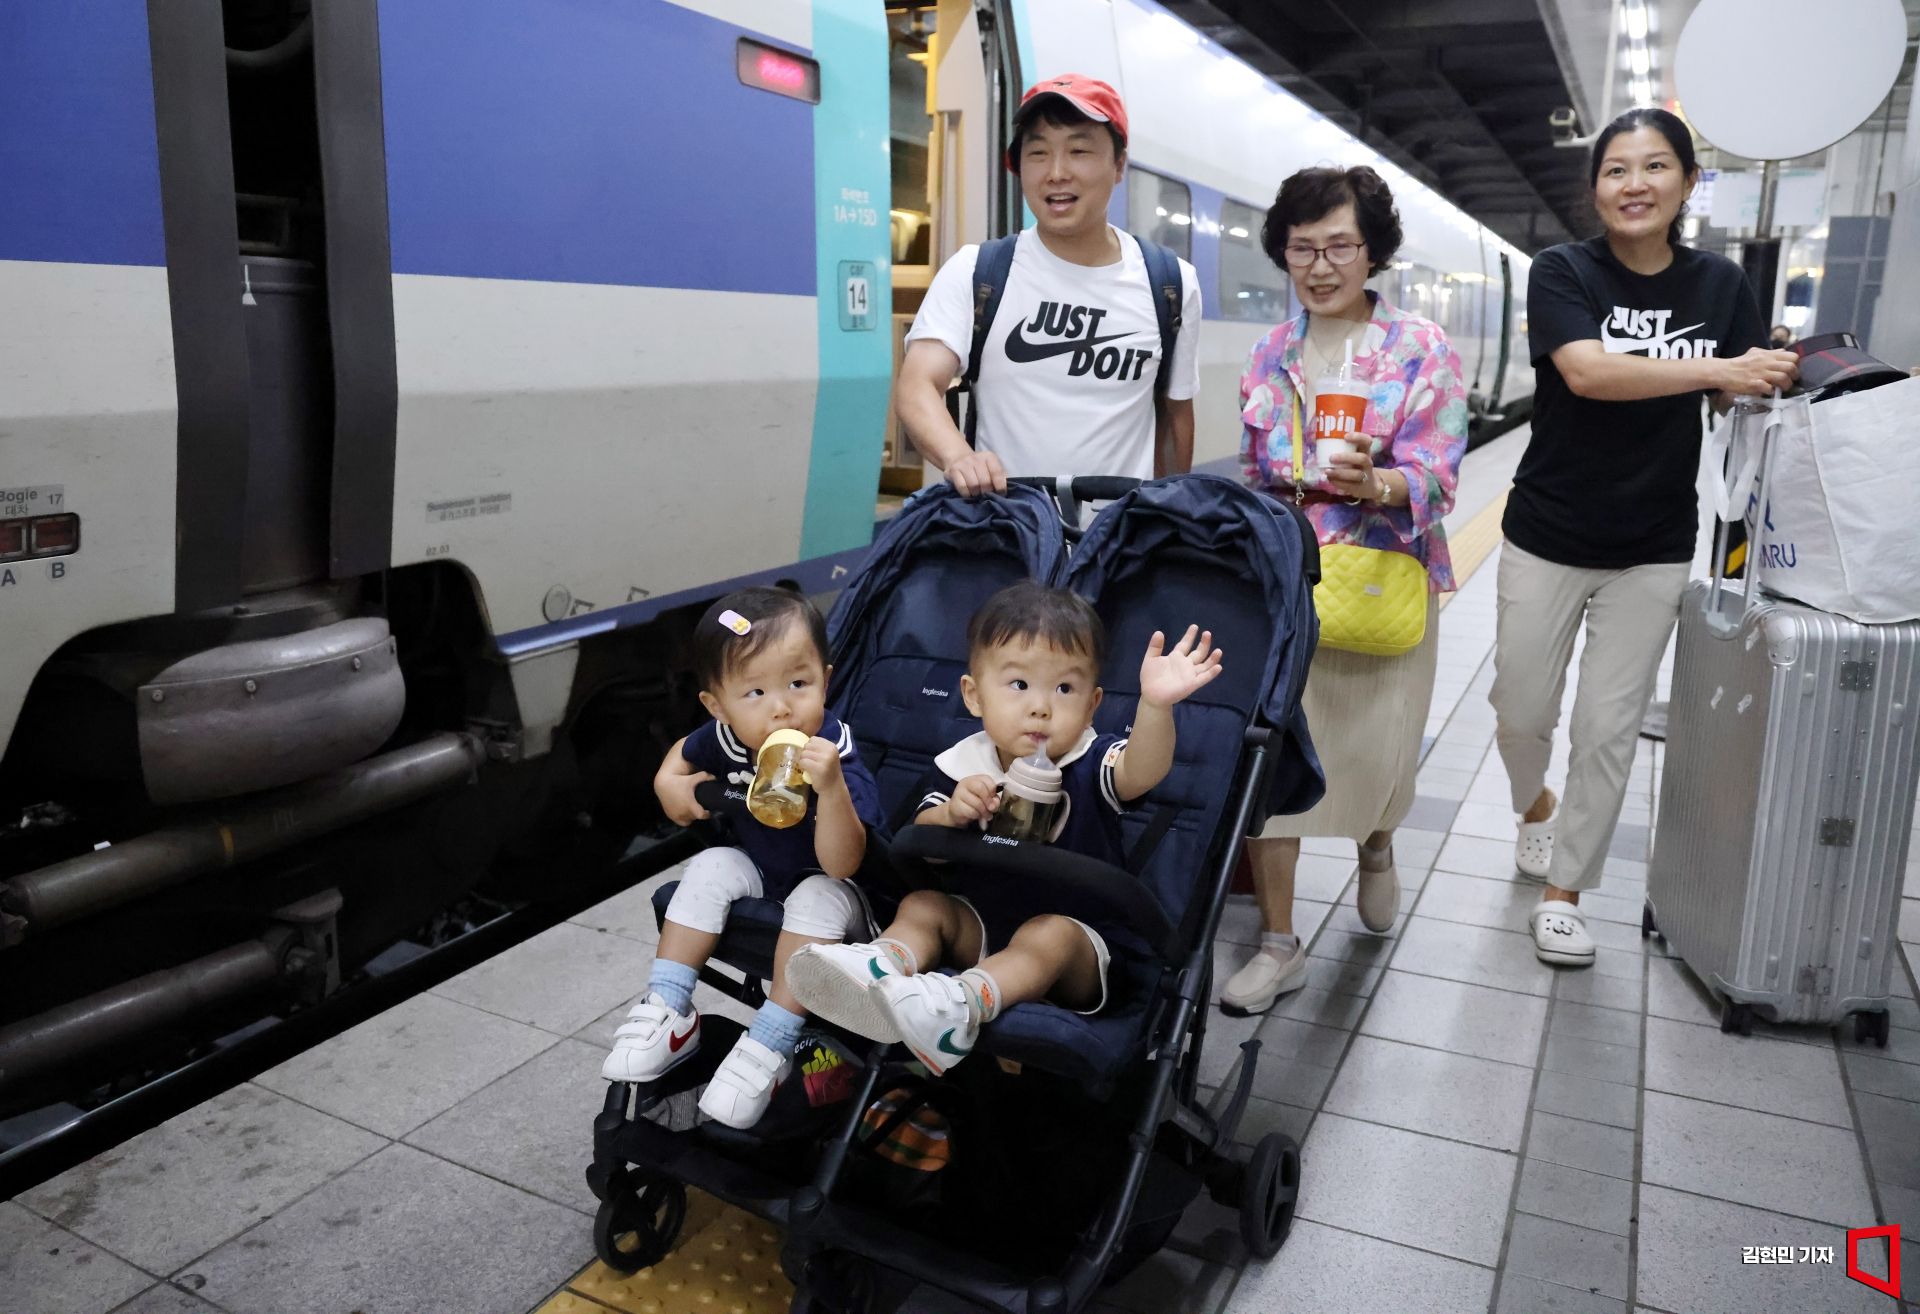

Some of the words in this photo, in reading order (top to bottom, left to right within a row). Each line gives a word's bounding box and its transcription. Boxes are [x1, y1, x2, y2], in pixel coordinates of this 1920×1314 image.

[849, 283, 866, 310] 14
[1027, 301, 1107, 340] JUST
[1610, 305, 1672, 339] JUST
[48, 493, 63, 505] 17
[1, 569, 17, 588] A
[51, 562, 66, 579] B
